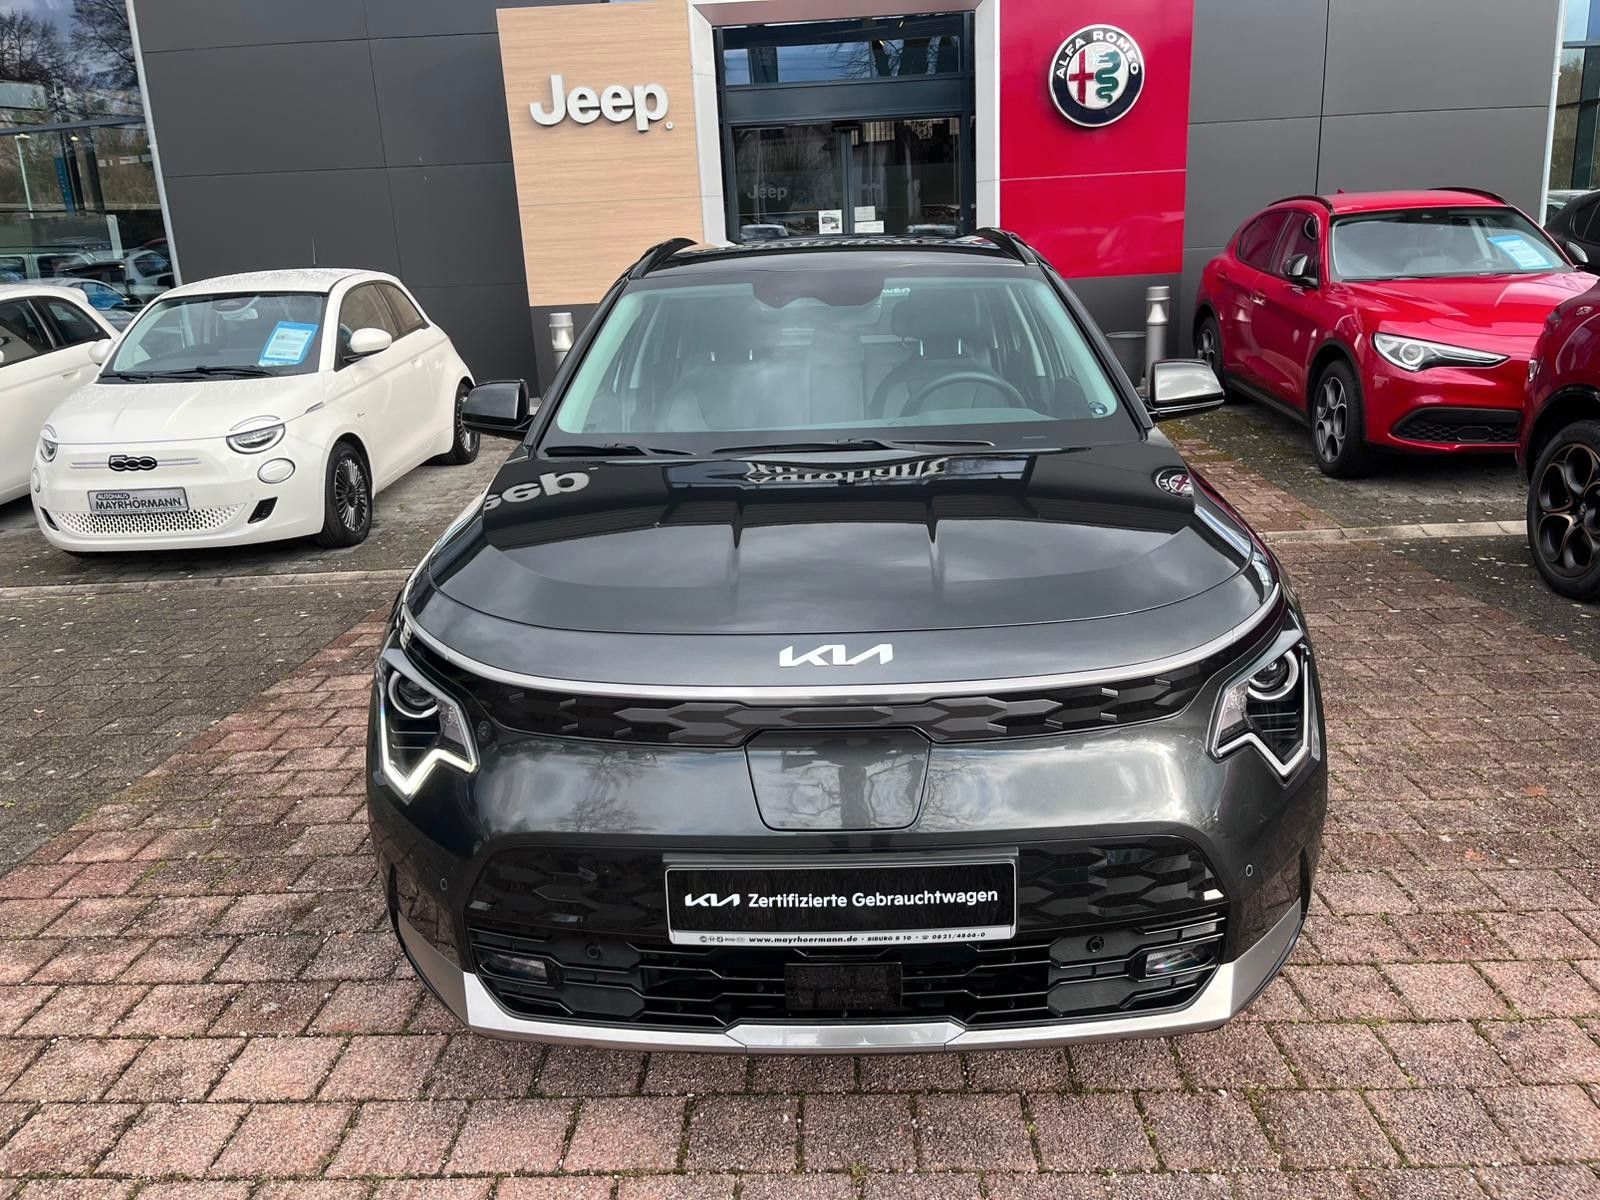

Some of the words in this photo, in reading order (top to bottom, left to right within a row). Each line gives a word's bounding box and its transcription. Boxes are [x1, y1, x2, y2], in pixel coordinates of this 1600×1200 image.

[1056, 38, 1087, 79] ALFA
[1093, 31, 1139, 75] ROMEO
[529, 74, 669, 132] Jeep
[747, 183, 788, 200] Jeep
[109, 455, 158, 472] 500
[95, 496, 182, 510] MAYRHÖRMANN
[779, 643, 894, 668] KIA
[684, 893, 741, 907] KIA
[748, 893, 847, 908] Zertifizierte
[852, 890, 998, 907] Gebrauchtwagen
[748, 935, 858, 944] www.mayrhoermann.de
[932, 932, 986, 940] 0821/4866-0
